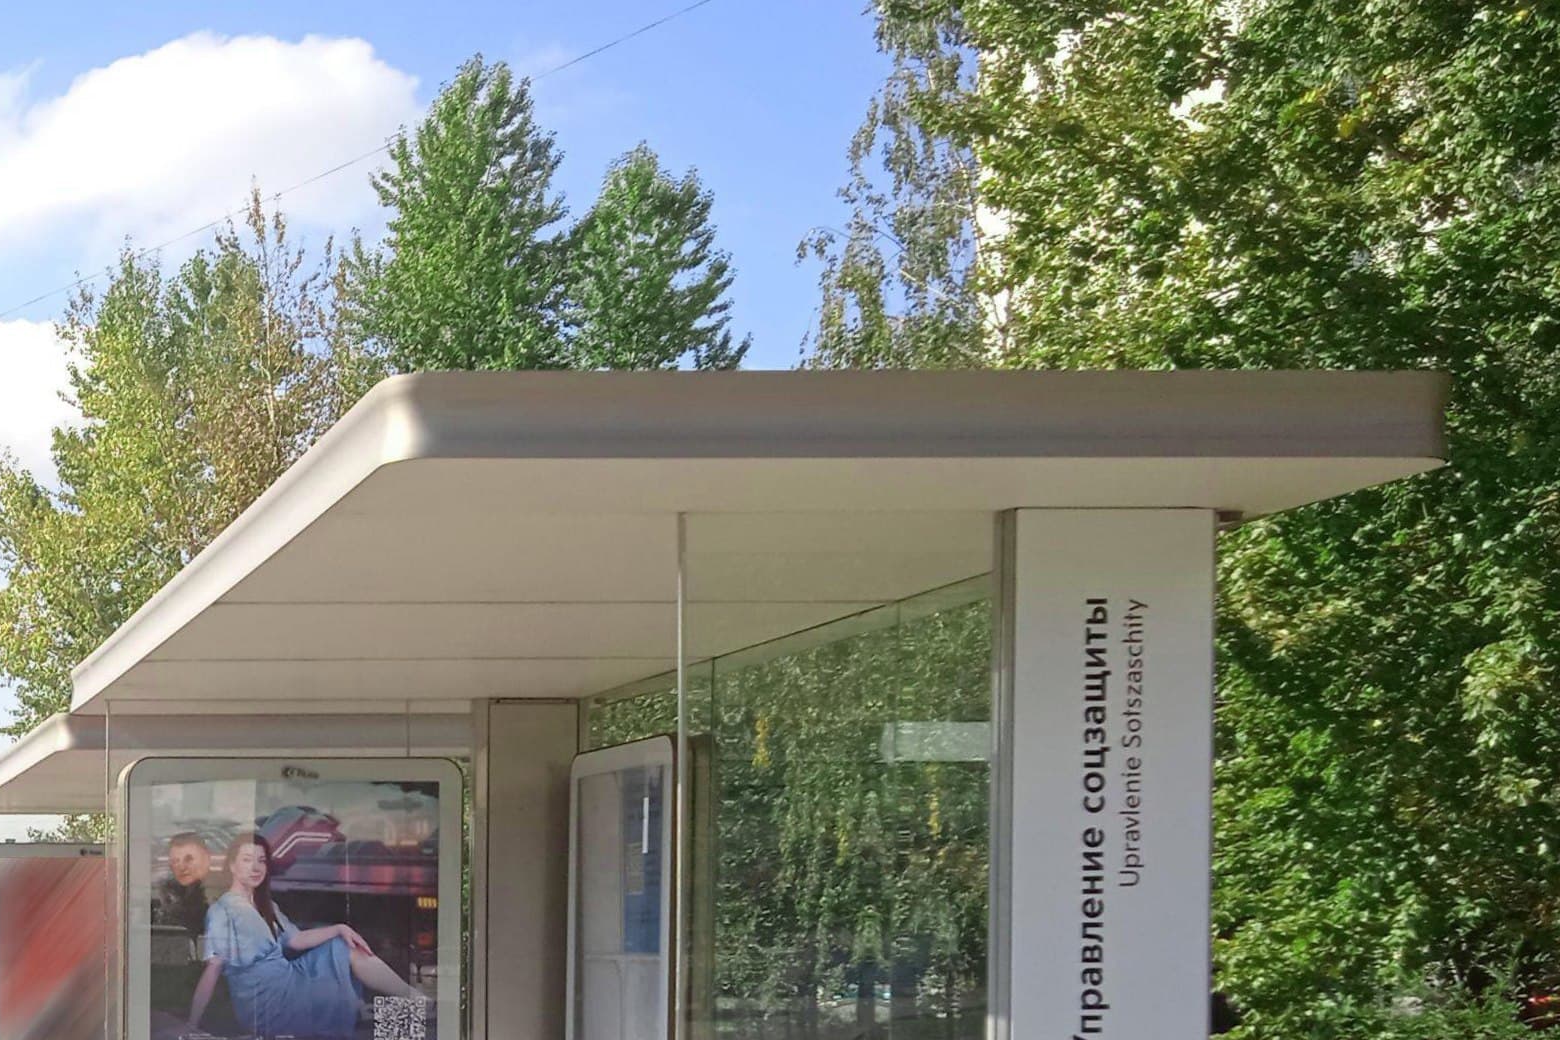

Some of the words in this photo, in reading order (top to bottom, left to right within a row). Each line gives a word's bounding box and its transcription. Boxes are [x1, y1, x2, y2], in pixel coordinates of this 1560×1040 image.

[1082, 597, 1110, 814] соцзащиты
[1121, 598, 1148, 750] Sotszaschity
[1119, 755, 1144, 888] Upravlenie
